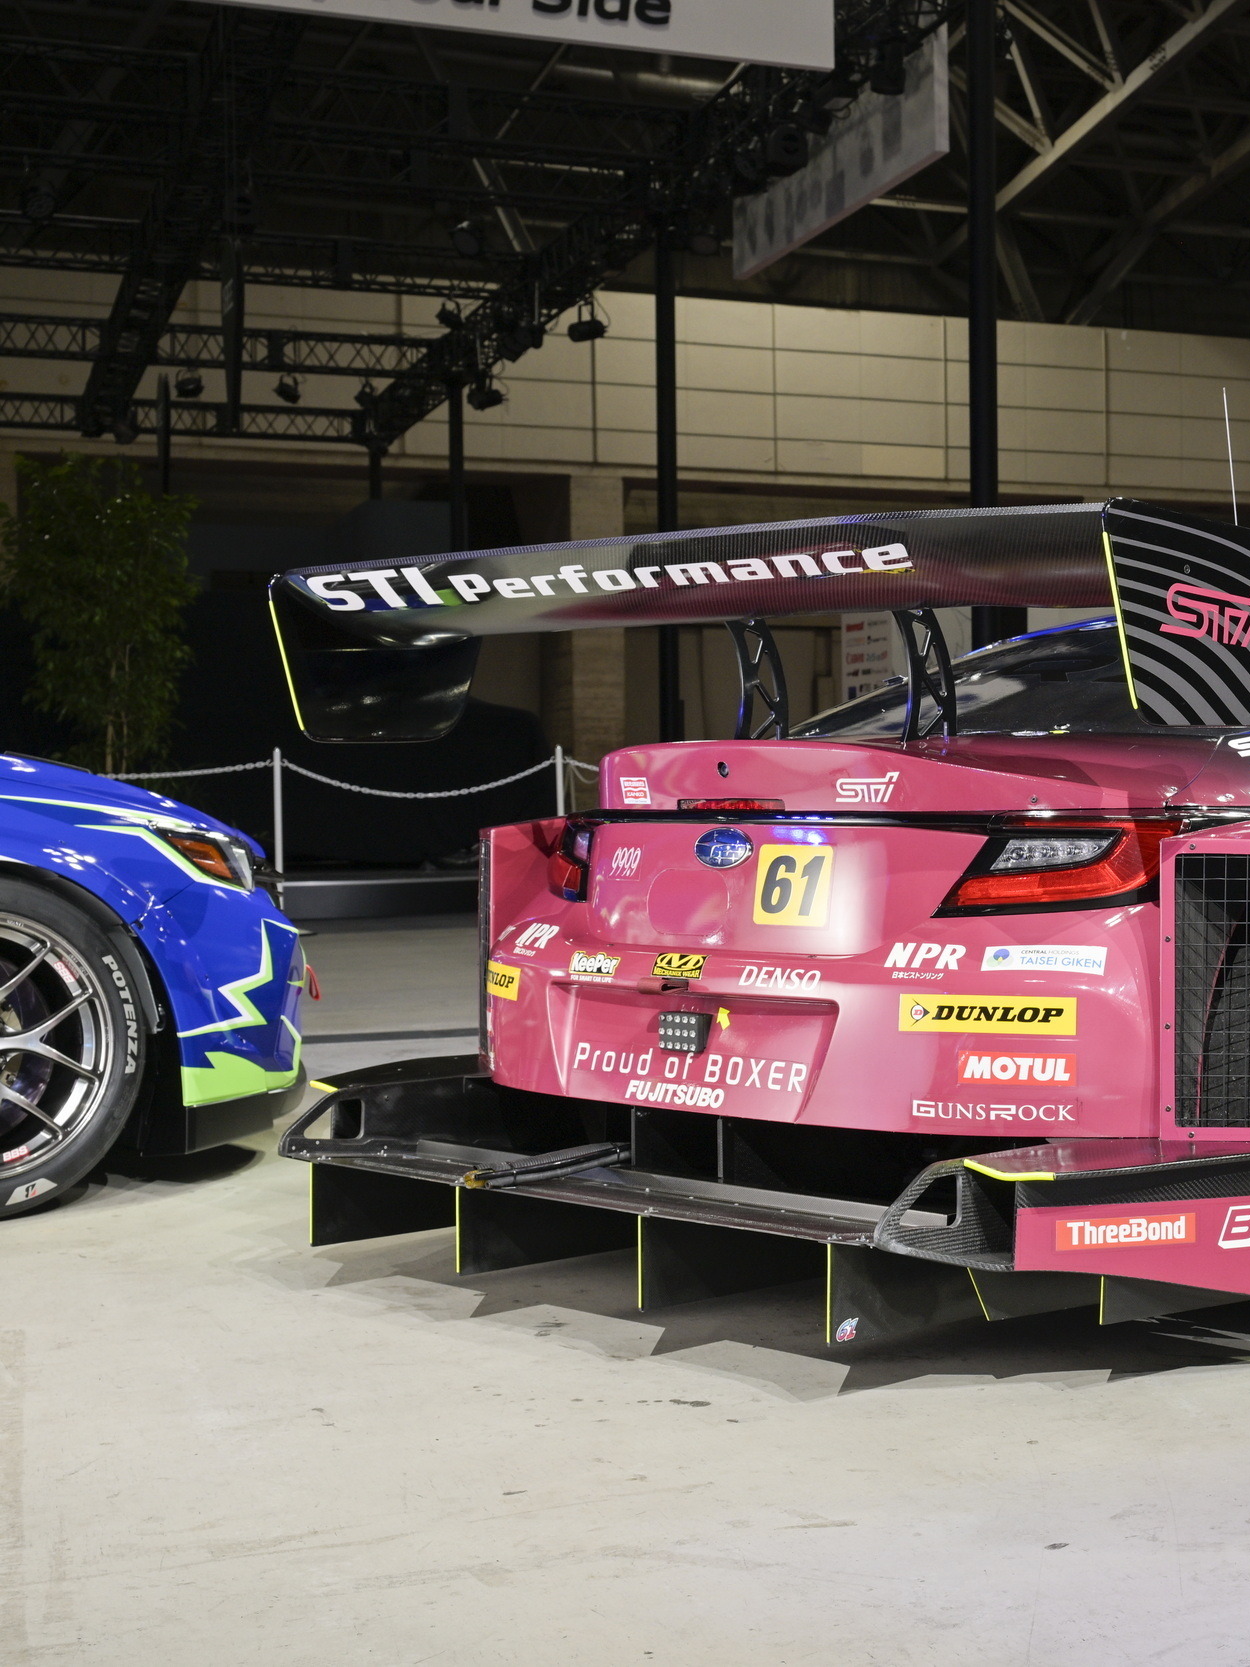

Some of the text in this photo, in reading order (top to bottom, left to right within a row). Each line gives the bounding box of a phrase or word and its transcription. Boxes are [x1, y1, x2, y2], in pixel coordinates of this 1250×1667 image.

[307, 543, 913, 612] STI Performance
[760, 855, 826, 917] 61
[515, 923, 560, 949] NPR
[572, 952, 620, 974] KeePer
[884, 942, 967, 970] NPR
[1020, 956, 1103, 969] TAISEI GIKEN
[738, 965, 822, 992] DENSO
[102, 954, 138, 1074] POTENZA
[931, 1005, 1064, 1023] DUNLOP
[573, 1042, 808, 1093] Proud of BOXER
[963, 1055, 1071, 1082] MOTUL
[624, 1079, 725, 1109] FUJITSUBO
[1066, 1215, 1186, 1245] ThreeBond
